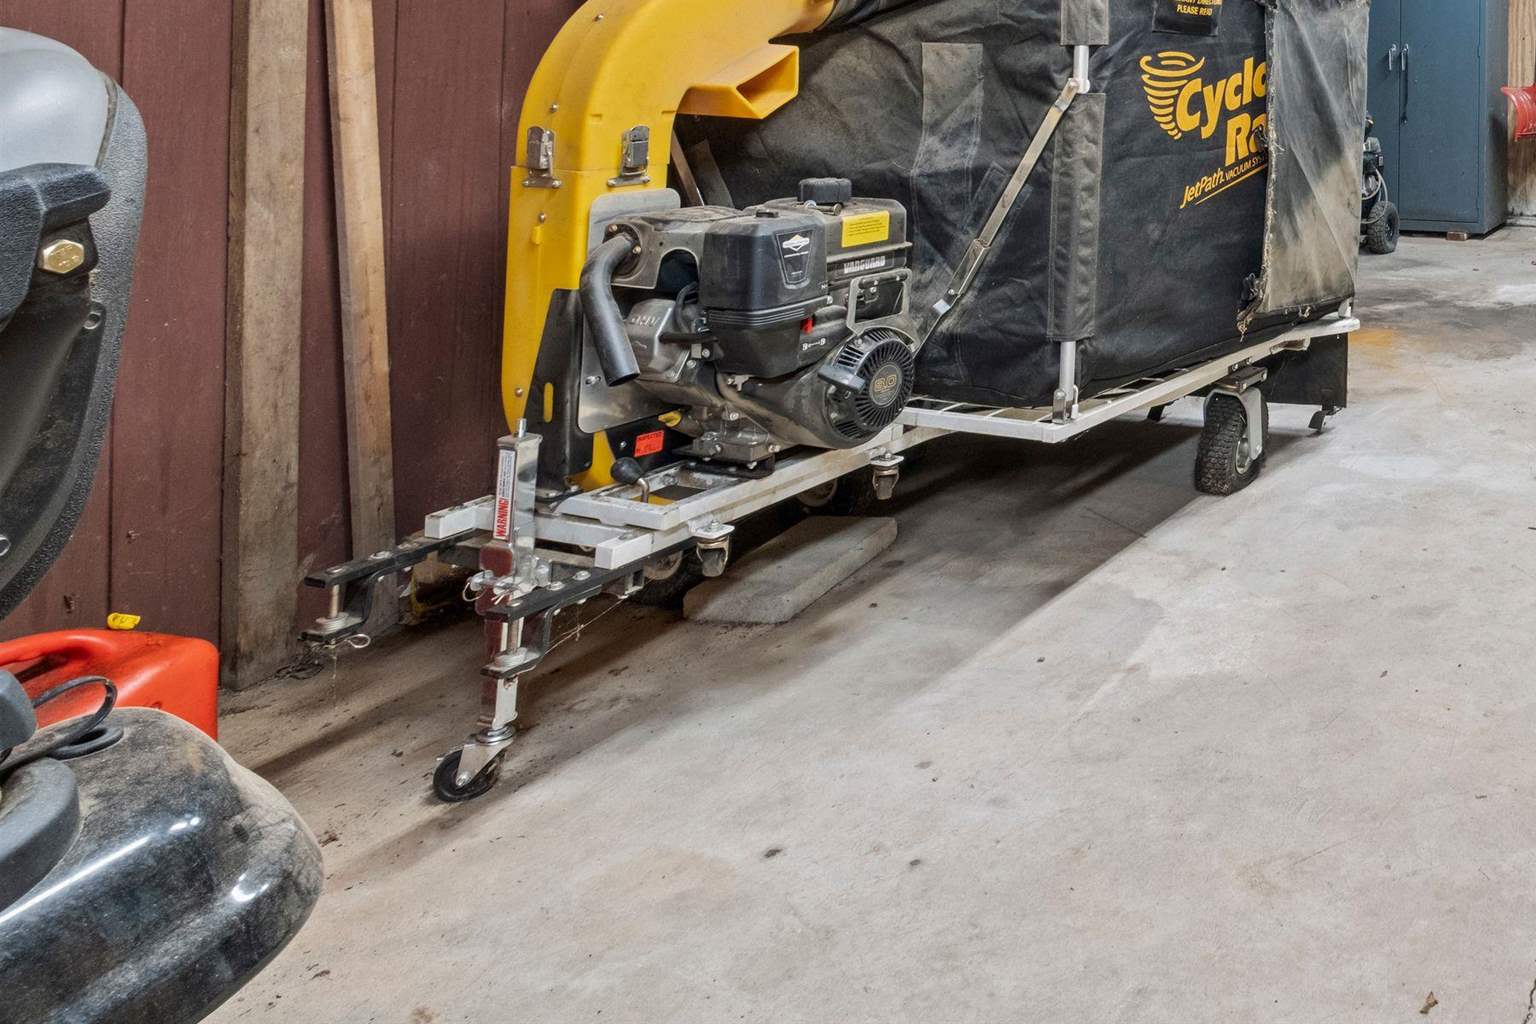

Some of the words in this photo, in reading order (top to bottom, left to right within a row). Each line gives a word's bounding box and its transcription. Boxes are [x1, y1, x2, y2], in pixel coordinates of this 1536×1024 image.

[1177, 4, 1199, 15] PLEASE
[1199, 7, 1213, 16] READ
[1180, 167, 1224, 209] JetPath
[844, 256, 886, 274] VANGUARD
